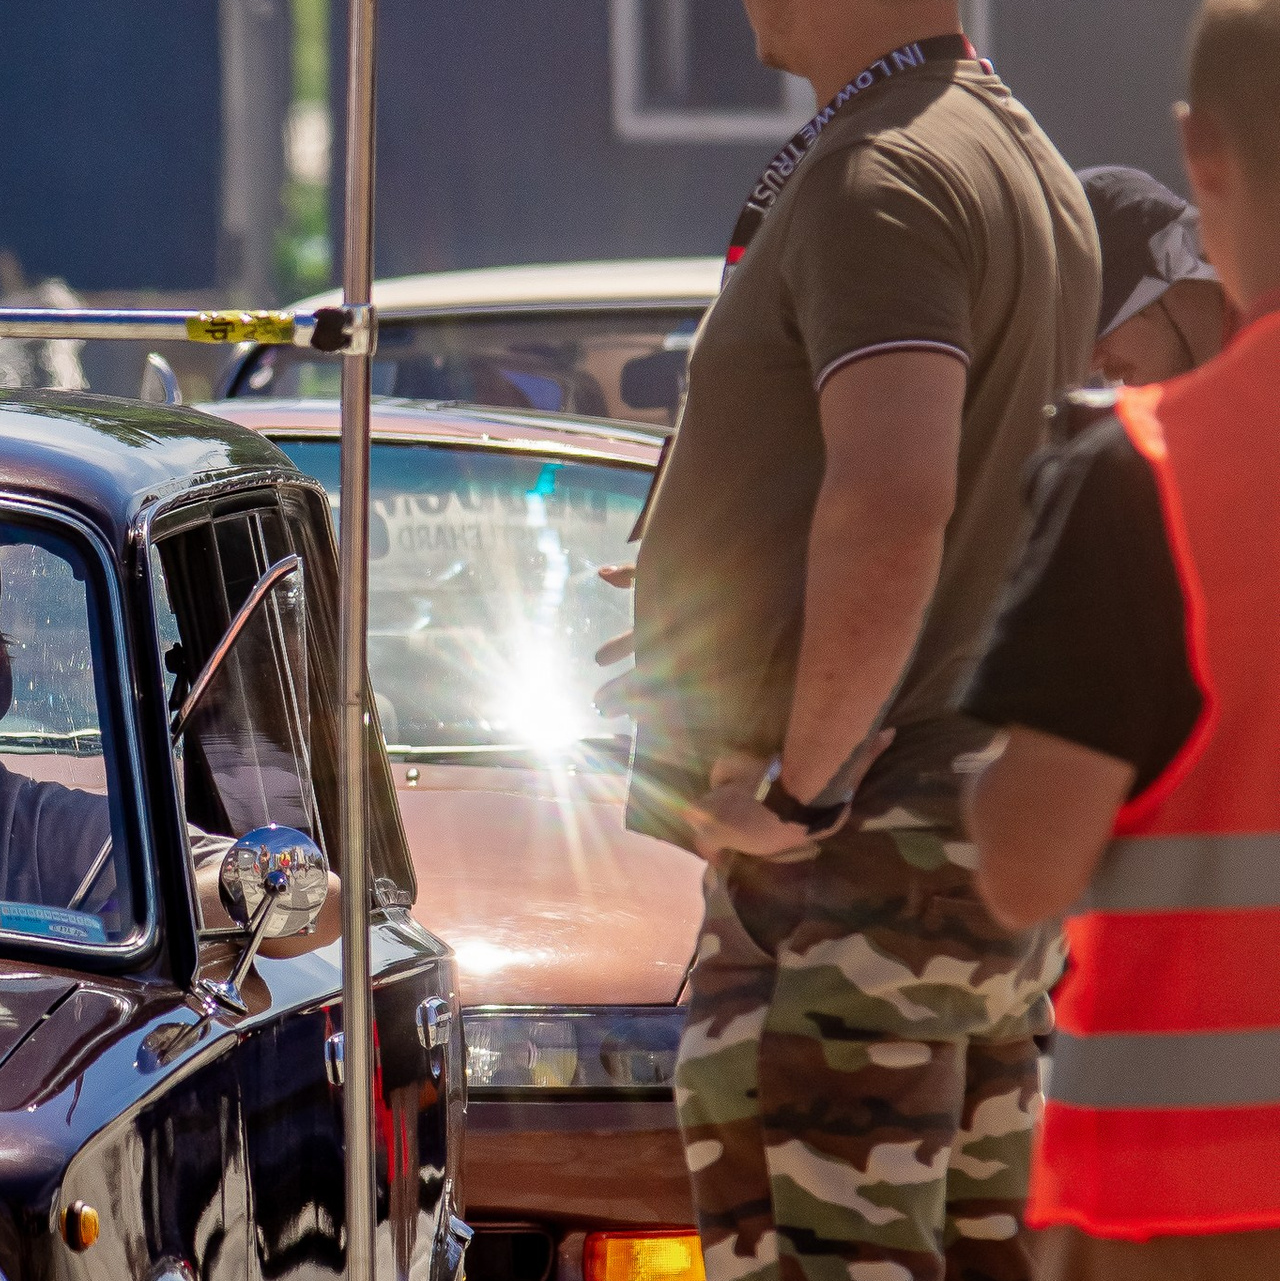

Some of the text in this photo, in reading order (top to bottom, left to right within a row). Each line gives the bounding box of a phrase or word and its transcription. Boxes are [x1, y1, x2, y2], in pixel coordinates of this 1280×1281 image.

[747, 42, 926, 213] IN LOW WE TRUST
